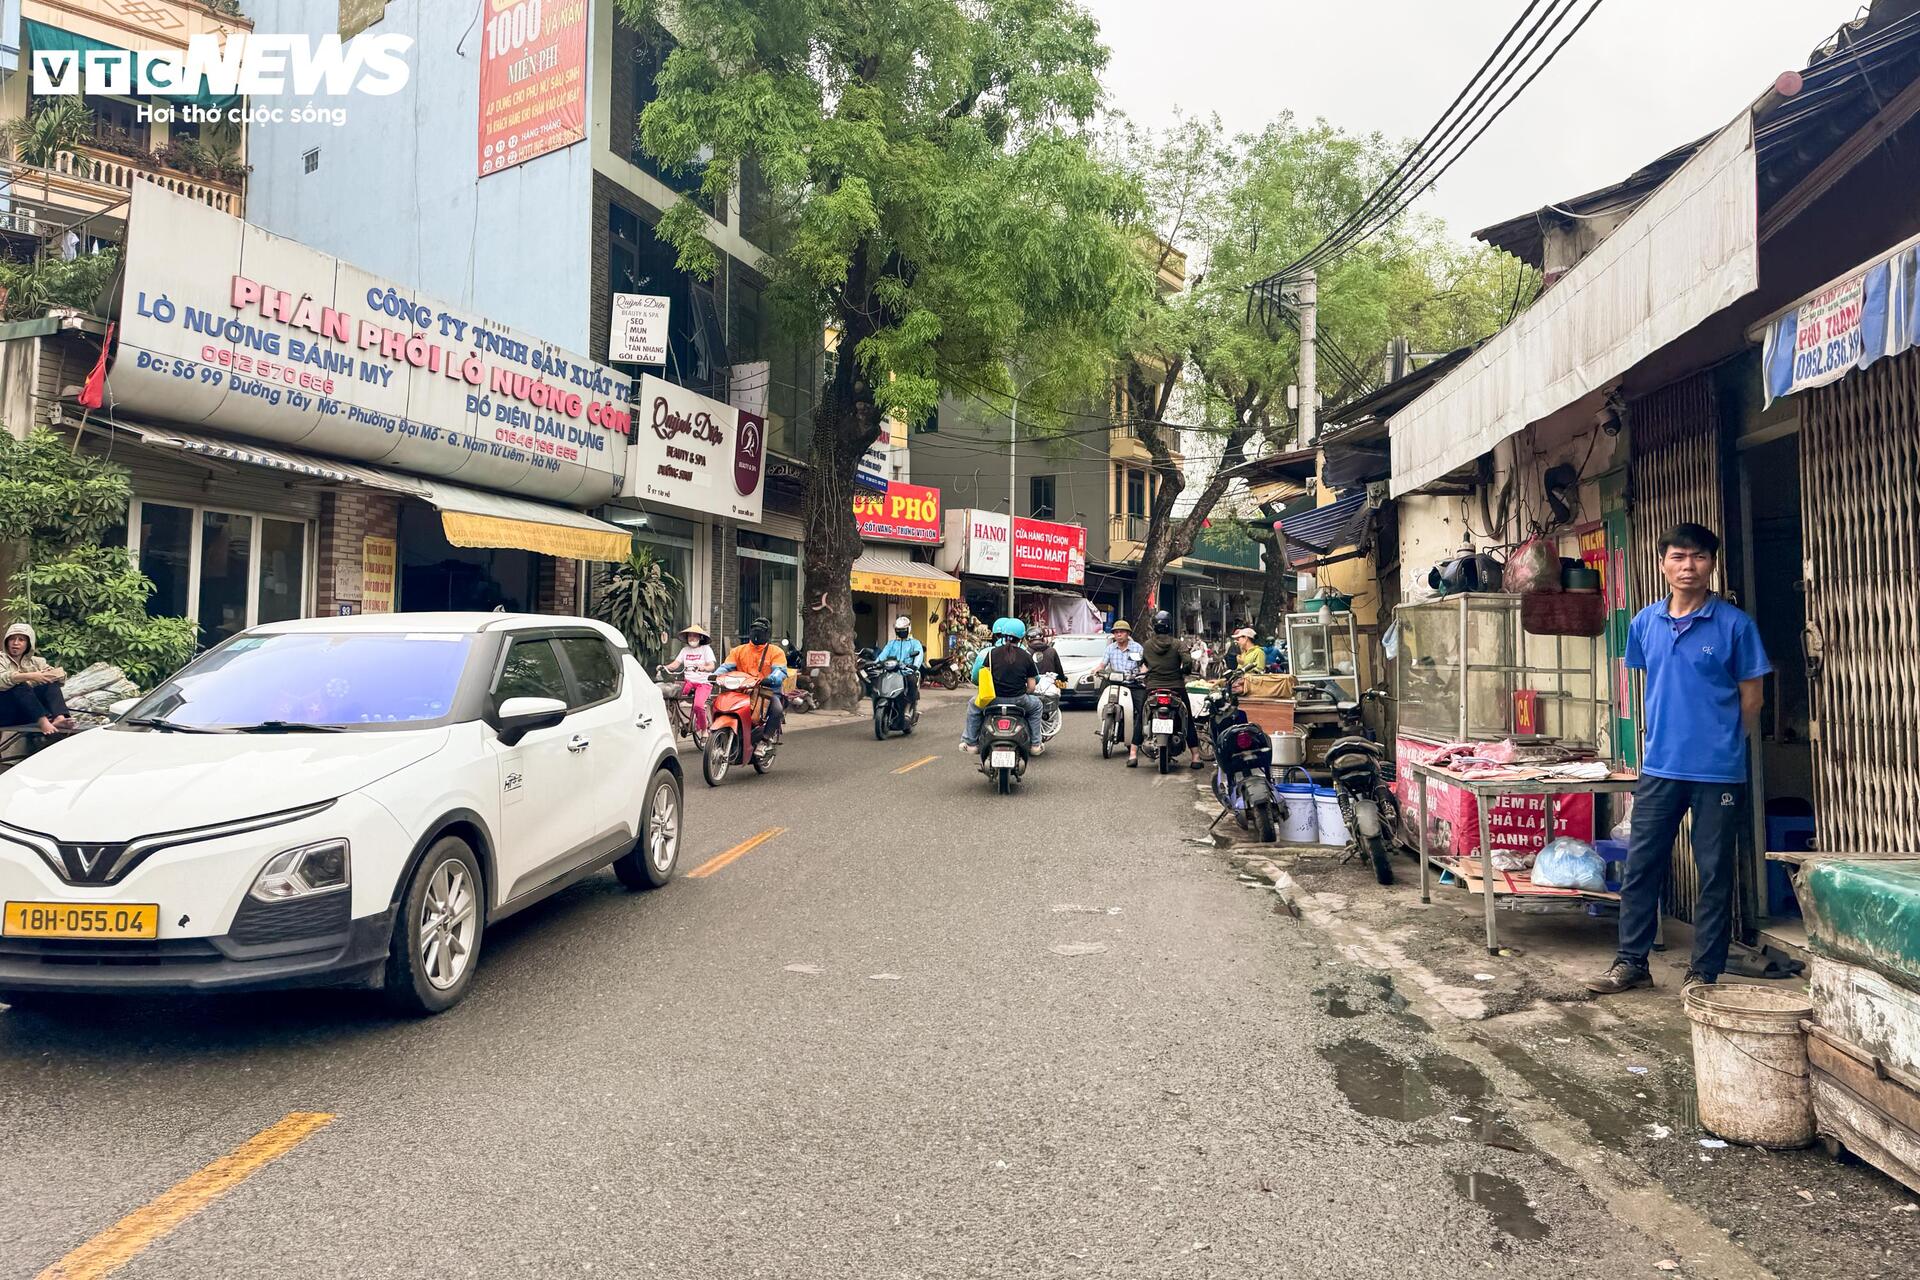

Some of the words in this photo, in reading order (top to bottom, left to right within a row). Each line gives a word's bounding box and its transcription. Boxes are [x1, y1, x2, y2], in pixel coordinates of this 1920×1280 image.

[487, 0, 541, 60] 1000
[137, 292, 175, 323] LÒ
[183, 306, 281, 355] NƯỚNG
[288, 338, 354, 377] BÁNH
[359, 361, 394, 388] MỲ
[231, 275, 350, 343] PHÂN
[358, 320, 441, 373] PHỐI
[445, 351, 485, 385] LÒ
[491, 367, 582, 419] NƯỚNG
[366, 287, 432, 329] CÔNG
[437, 312, 468, 342] TY
[472, 326, 529, 366] TNHH
[532, 346, 568, 379] SẢN
[570, 363, 612, 396] XUẤT
[202, 345, 253, 373] 0912
[256, 359, 296, 384] 570
[172, 359, 196, 380] Số
[201, 367, 223, 386] 99
[229, 374, 281, 405] Đường
[287, 389, 312, 411] Tây
[348, 406, 396, 433] Phường
[398, 417, 419, 438] Đại
[463, 436, 488, 453] Nam
[502, 446, 525, 462] Liêm
[531, 455, 544, 468] Hà
[545, 460, 561, 473] Nội
[495, 403, 531, 430] ĐIỆN
[534, 416, 565, 439] DÂN
[568, 426, 604, 451] DỤNG
[891, 491, 937, 522] PHỞ
[974, 523, 1007, 542] HANOI
[1015, 528, 1028, 539] CỬA
[1028, 530, 1045, 542] HÀNG
[1045, 534, 1053, 545] TỰ
[1053, 535, 1069, 547] CHỌN
[1015, 545, 1043, 560] HELLO
[1044, 548, 1067, 563] MART
[341, 606, 351, 616] 93
[1518, 694, 1530, 727] CÁ
[1517, 814, 1536, 829] LÁ
[20, 908, 143, 932] 18H-055.04
